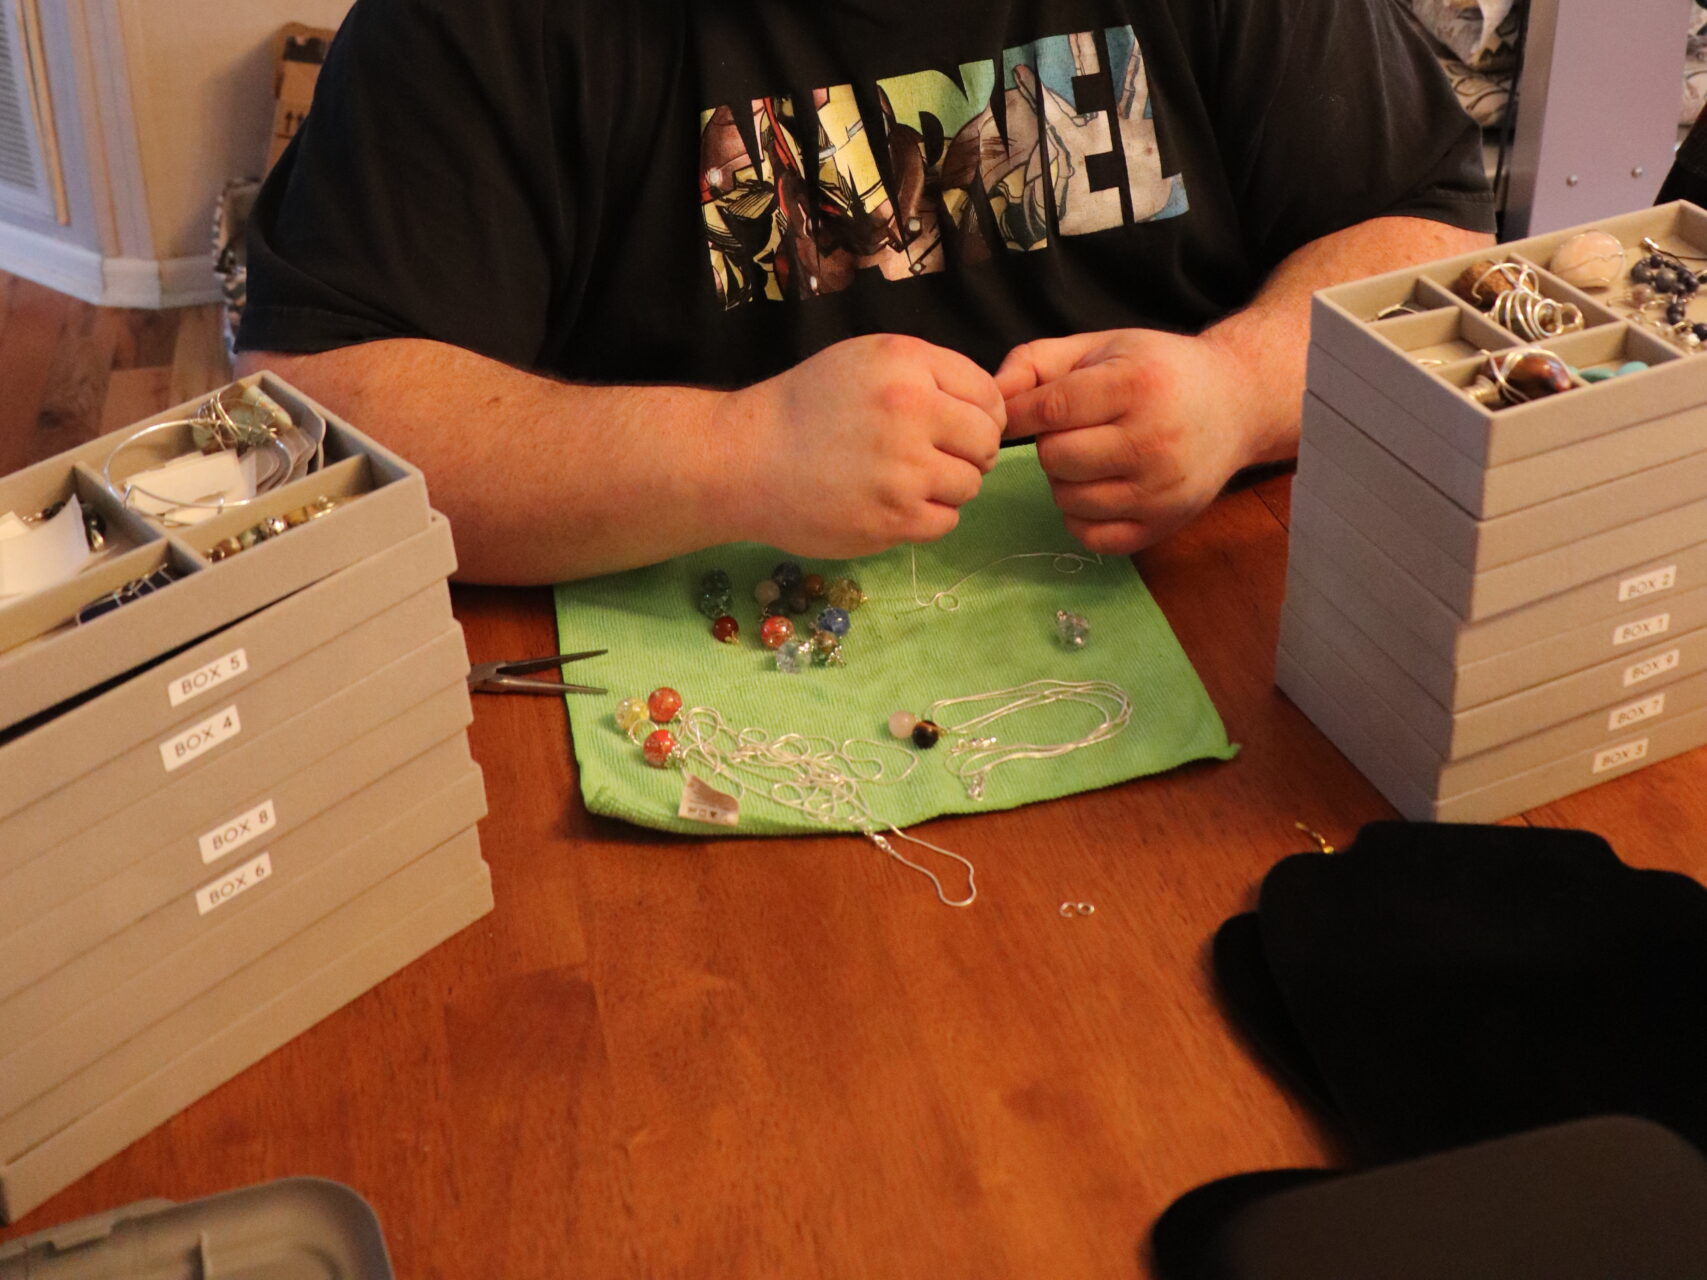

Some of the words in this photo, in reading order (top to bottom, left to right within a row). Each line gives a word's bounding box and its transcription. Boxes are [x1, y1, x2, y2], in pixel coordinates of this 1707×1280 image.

[700, 24, 1191, 312] MARVEL
[1628, 577, 1656, 598] BOX
[1622, 621, 1650, 641] BOX
[181, 666, 221, 695] BOX
[230, 656, 241, 671] 5
[1632, 659, 1659, 680] BOX
[1617, 705, 1646, 725] BOX
[175, 725, 214, 757] BOX
[222, 715, 233, 730] 4
[1602, 749, 1629, 767] BOX
[212, 819, 252, 851] BOX
[258, 809, 269, 824] 8
[208, 873, 248, 905] BOX
[255, 862, 266, 878] 6
